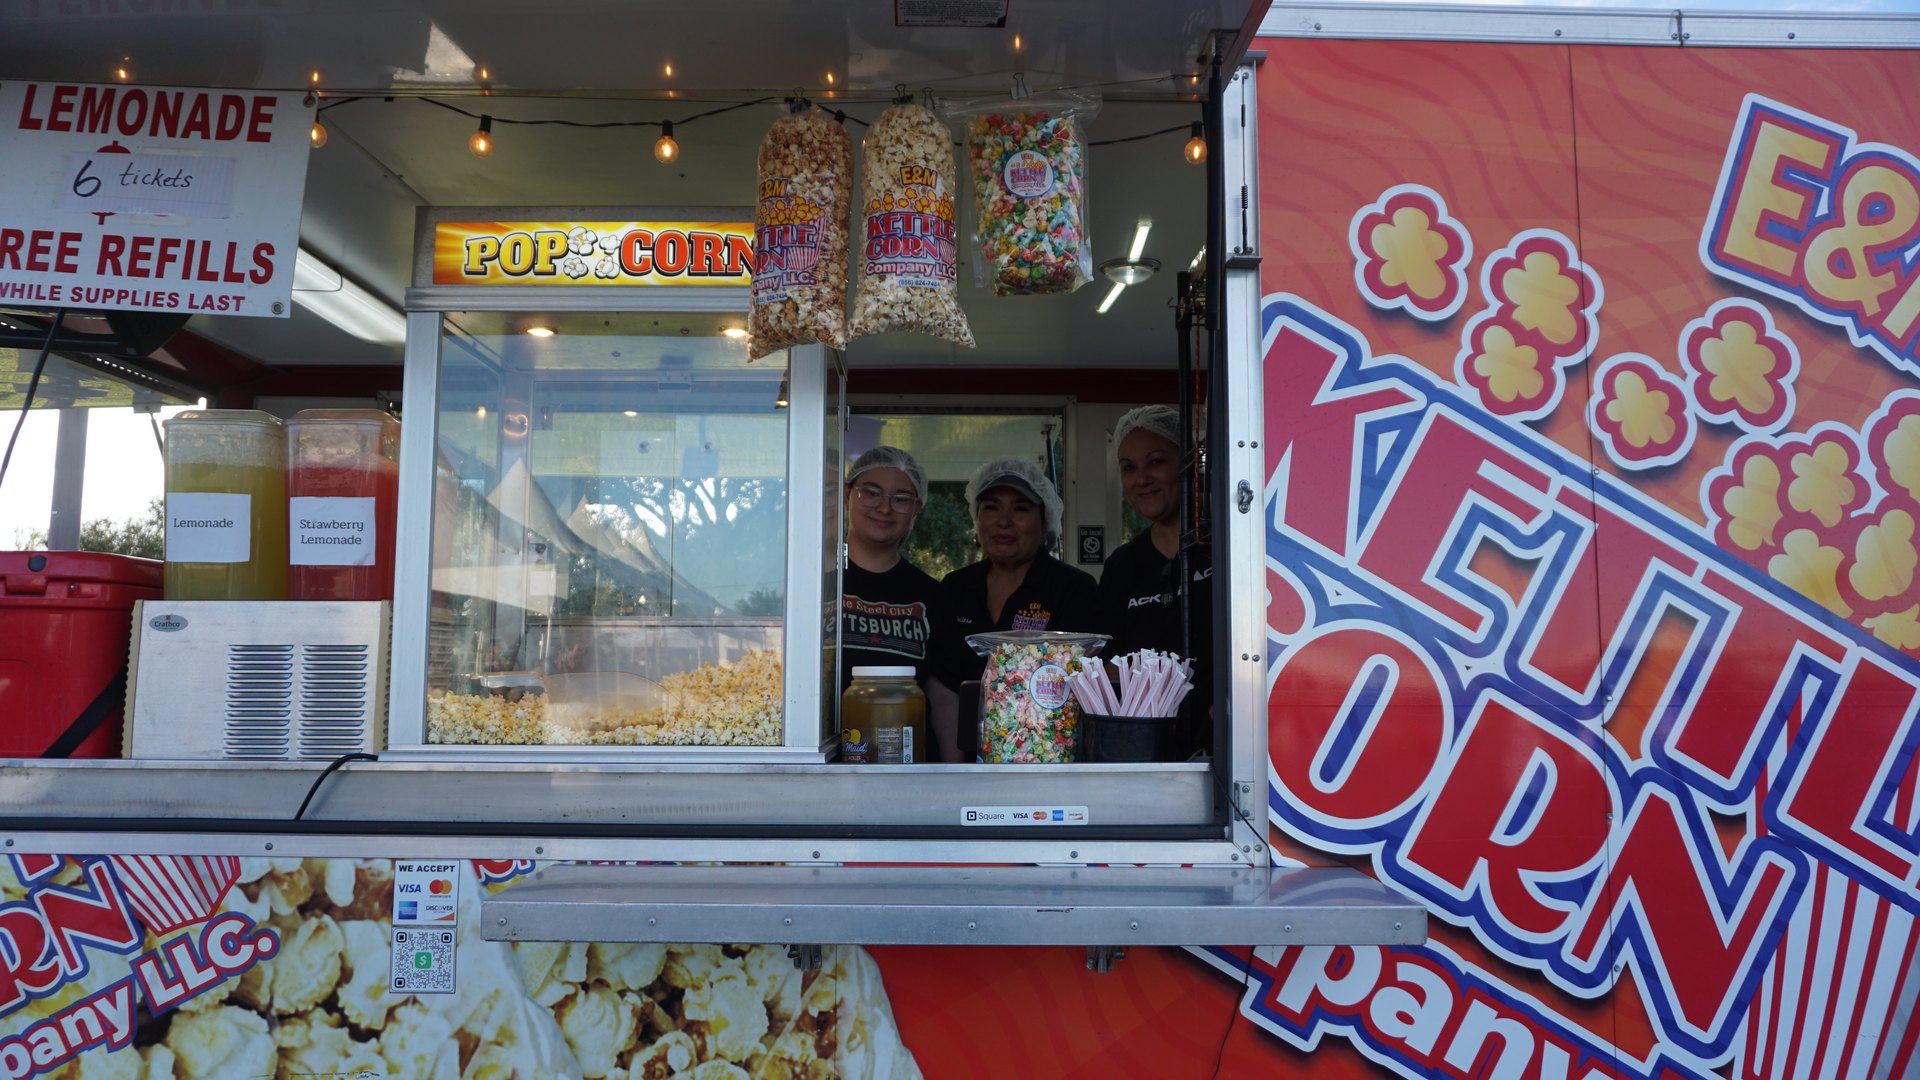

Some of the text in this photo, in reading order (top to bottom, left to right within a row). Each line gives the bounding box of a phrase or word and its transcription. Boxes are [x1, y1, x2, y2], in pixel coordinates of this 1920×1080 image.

[18, 84, 278, 143] LEMONADE
[73, 160, 193, 197] 6 tickets
[902, 165, 938, 189] E&M
[96, 234, 276, 285] REFILLS
[463, 230, 569, 277] POP
[866, 236, 940, 260] CORN
[866, 262, 932, 277] Company
[70, 286, 180, 308] SUPPLIES
[188, 292, 246, 312] LAST
[173, 518, 234, 529] Lemonade
[300, 519, 364, 532] Strawberry
[300, 534, 362, 545] Lemonade
[857, 600, 886, 615] Steel
[889, 606, 913, 617] City
[1262, 318, 1920, 895] KETTL
[154, 620, 181, 628] Crathco
[843, 612, 924, 642] TSBURGH
[1264, 560, 1795, 1042] ORN
[979, 812, 1005, 821] Square
[398, 864, 456, 873] WE ACCEPT
[398, 883, 422, 893] VISA
[138, 917, 273, 1008] LLC.
